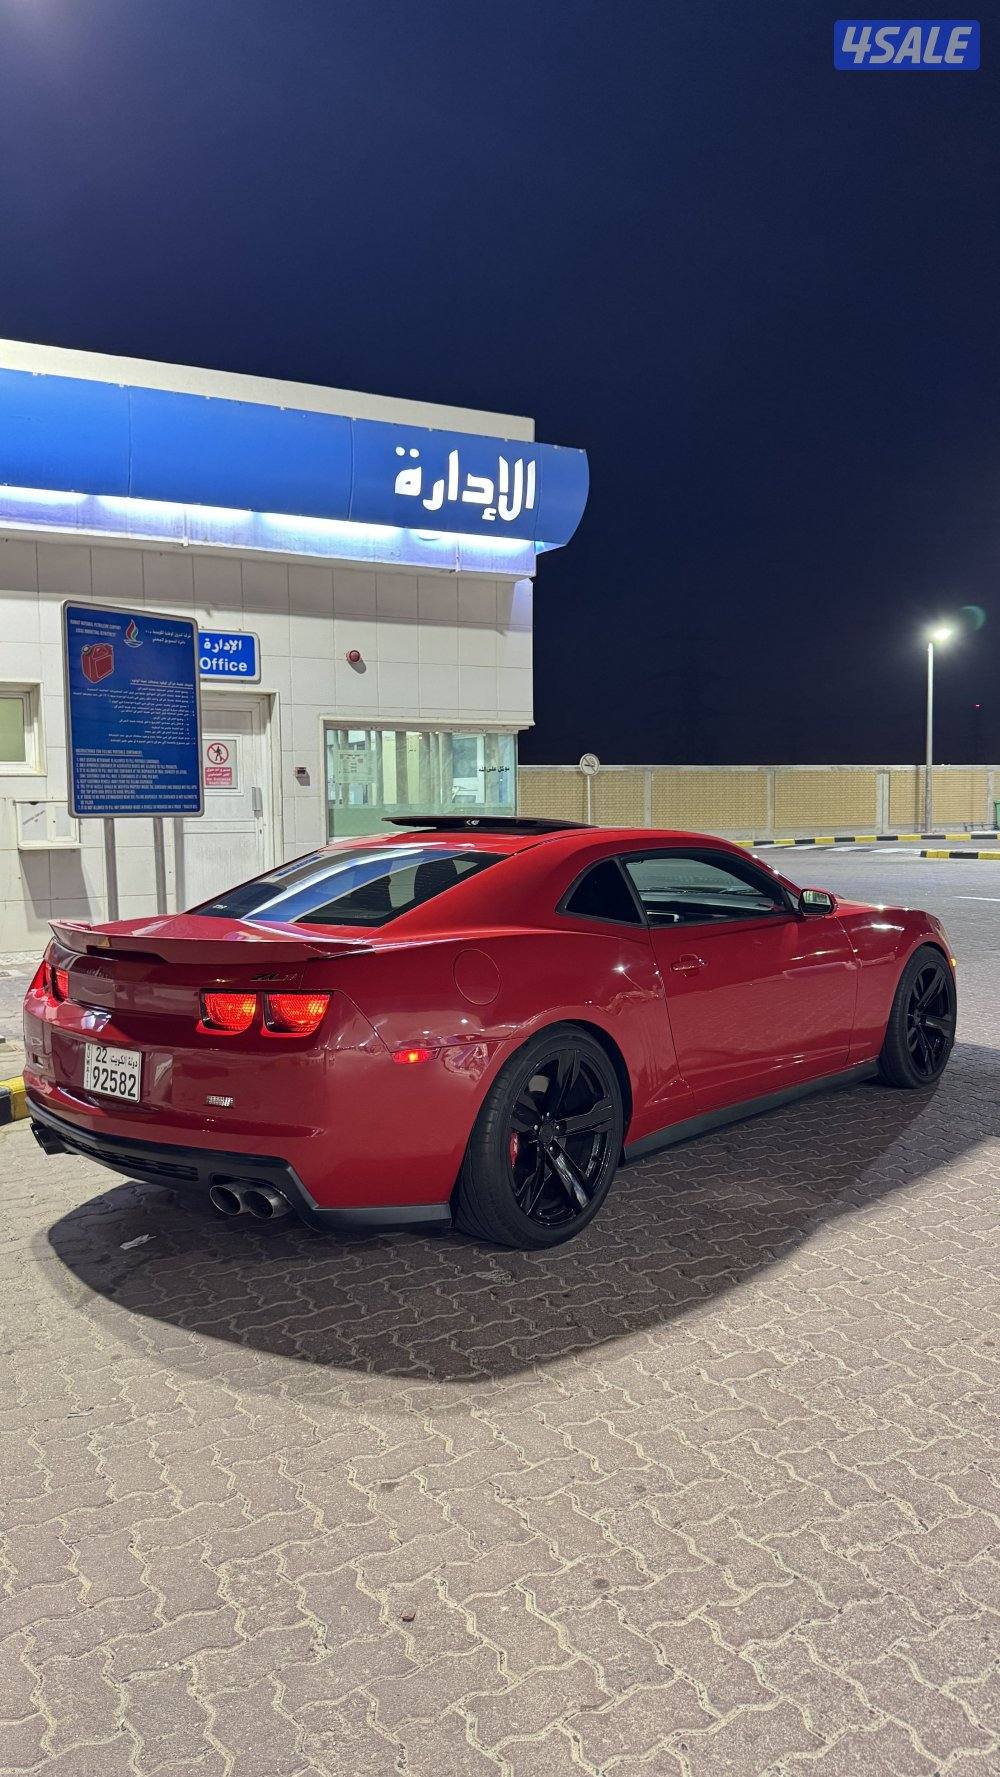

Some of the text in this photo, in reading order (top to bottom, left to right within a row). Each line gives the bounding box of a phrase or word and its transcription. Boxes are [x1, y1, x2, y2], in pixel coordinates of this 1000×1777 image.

[395, 446, 536, 521] الإدارة
[203, 638, 243, 654] الإدارة
[200, 657, 248, 672] Office
[95, 1046, 107, 1064] 22
[93, 1066, 137, 1098] 92582
